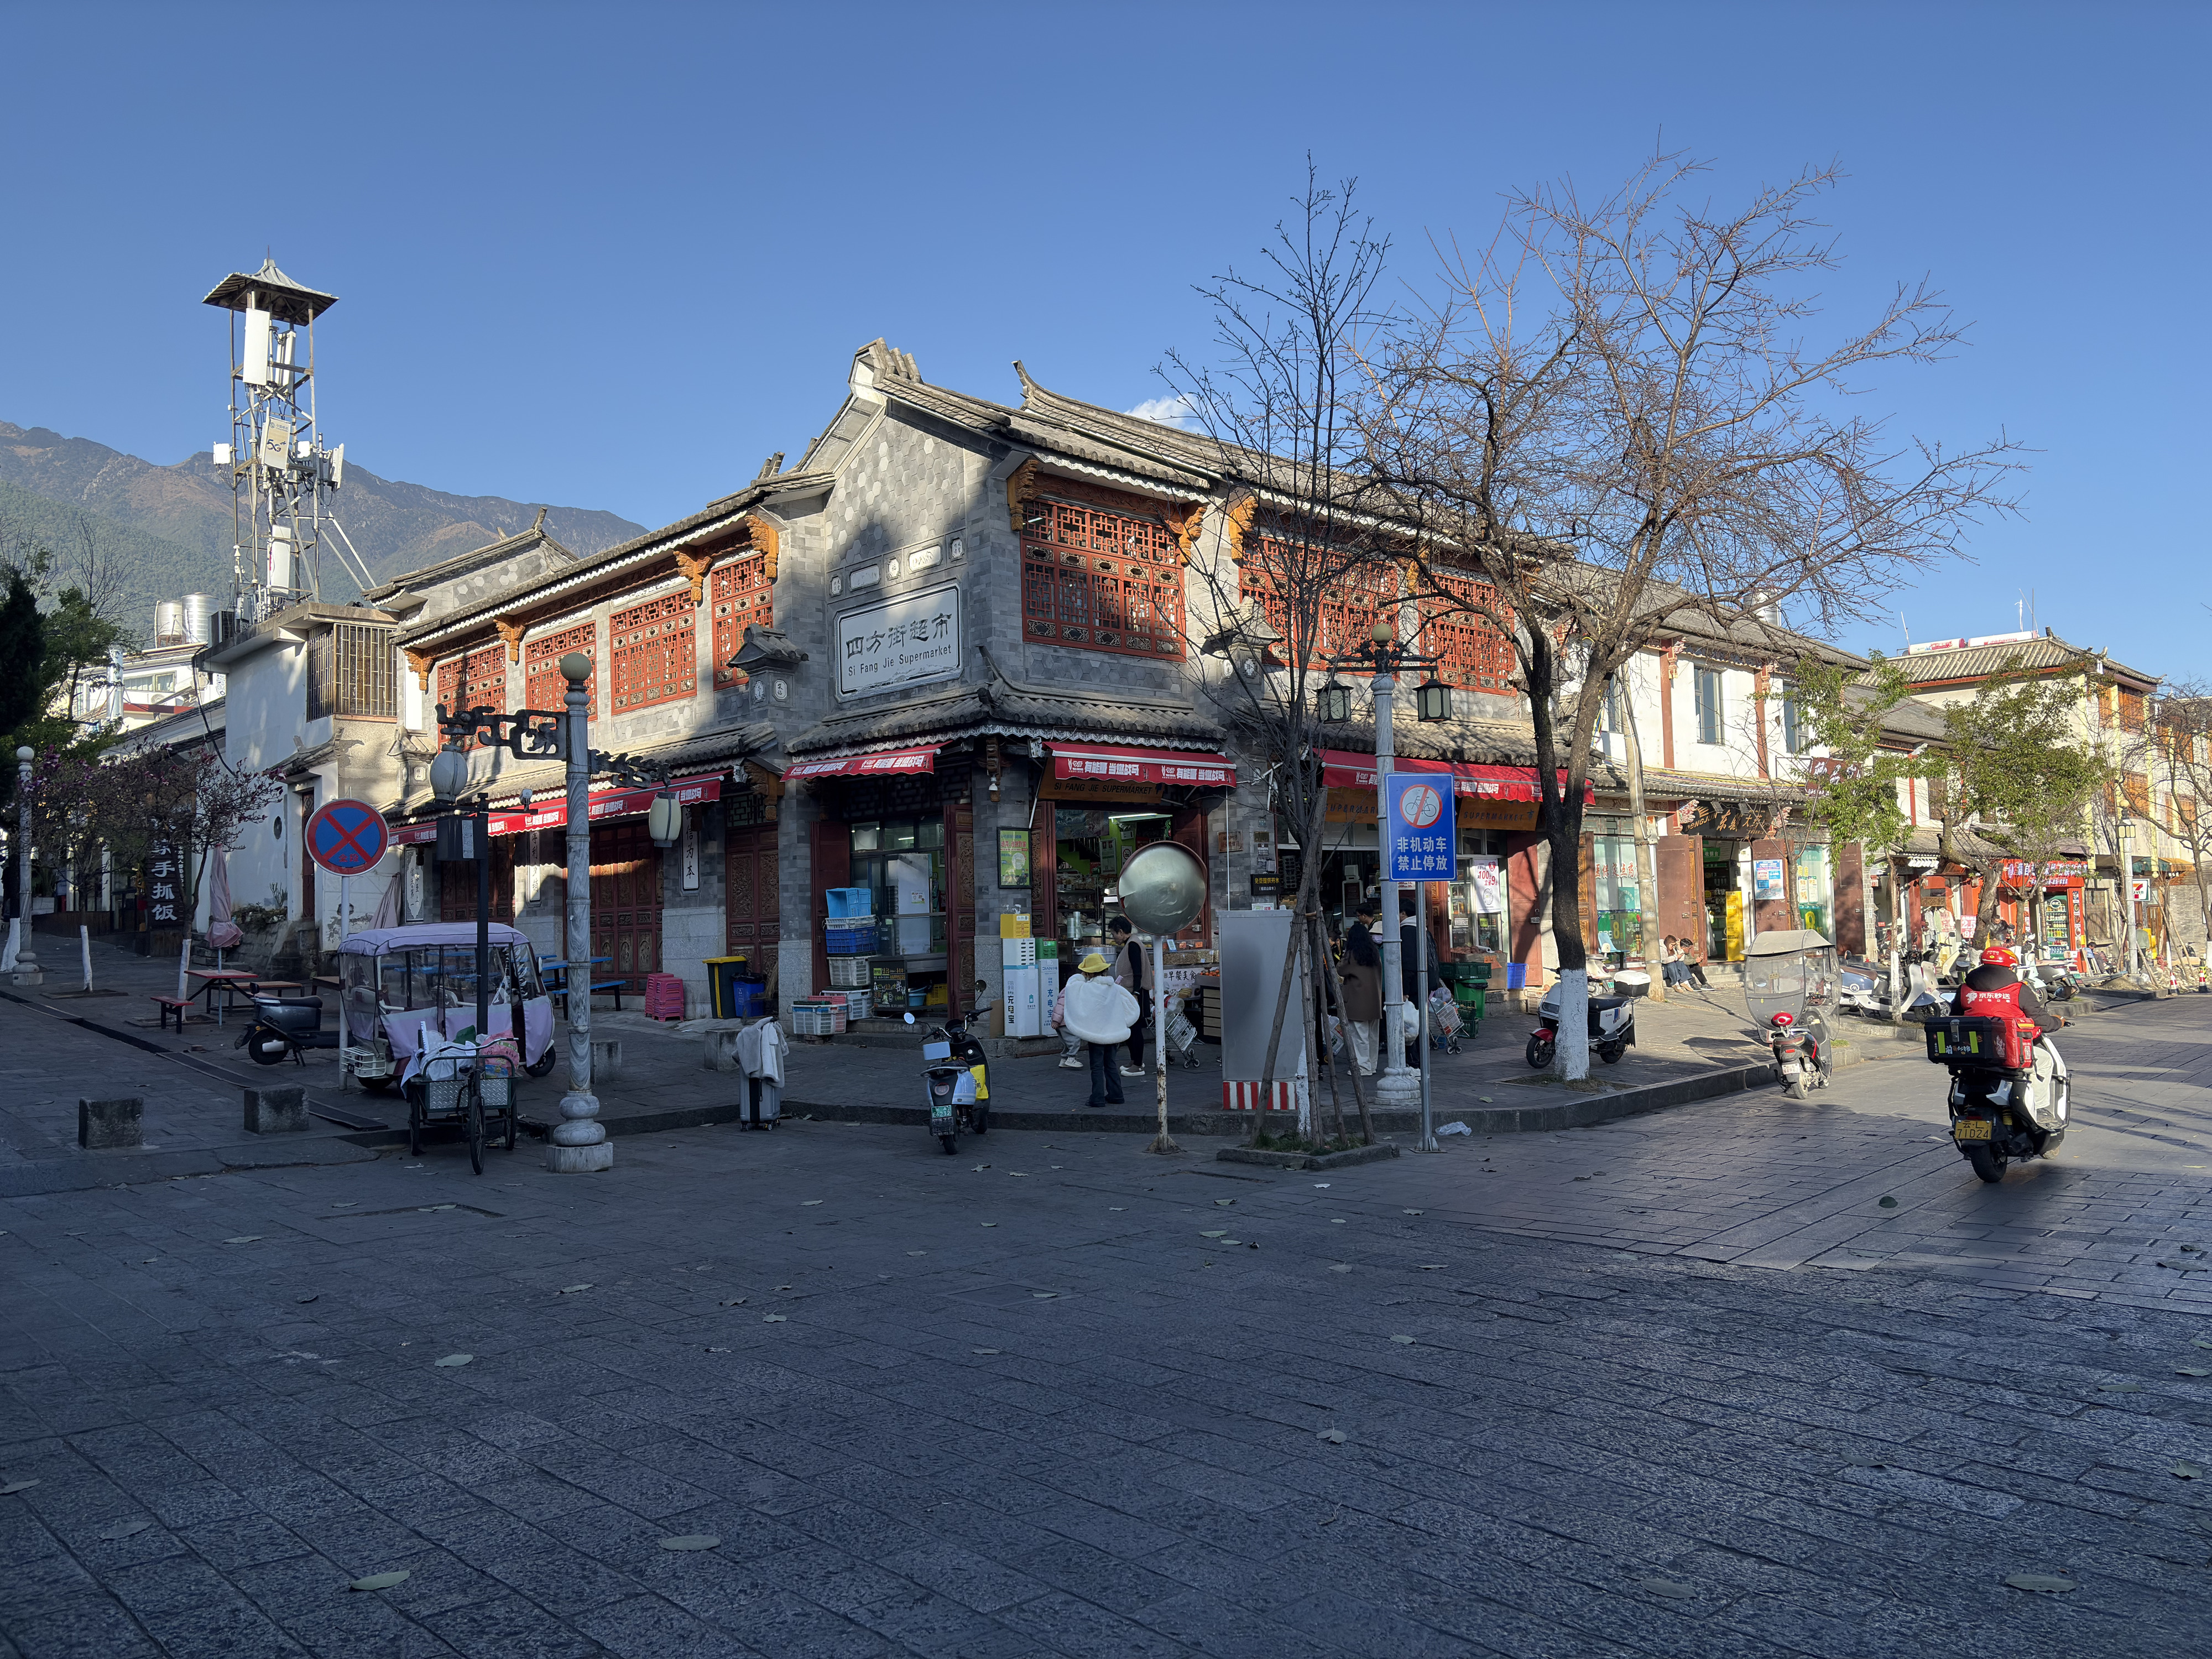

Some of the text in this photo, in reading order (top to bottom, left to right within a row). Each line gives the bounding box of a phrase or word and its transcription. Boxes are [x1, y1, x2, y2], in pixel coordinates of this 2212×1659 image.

[846, 612, 952, 659] 四方街超市
[848, 644, 952, 677] Si Fang Jie Supermarket
[1084, 761, 1108, 774] 有能量
[1176, 767, 1197, 781] 有能量
[1065, 782, 1084, 791] FANG
[1102, 785, 1152, 795] SUPERMARKET
[1464, 811, 1524, 822] SUPERMARKET
[1397, 836, 1447, 853] 非机动车
[1397, 855, 1448, 872] 禁止停放
[1168, 971, 1196, 982] 早餐美食
